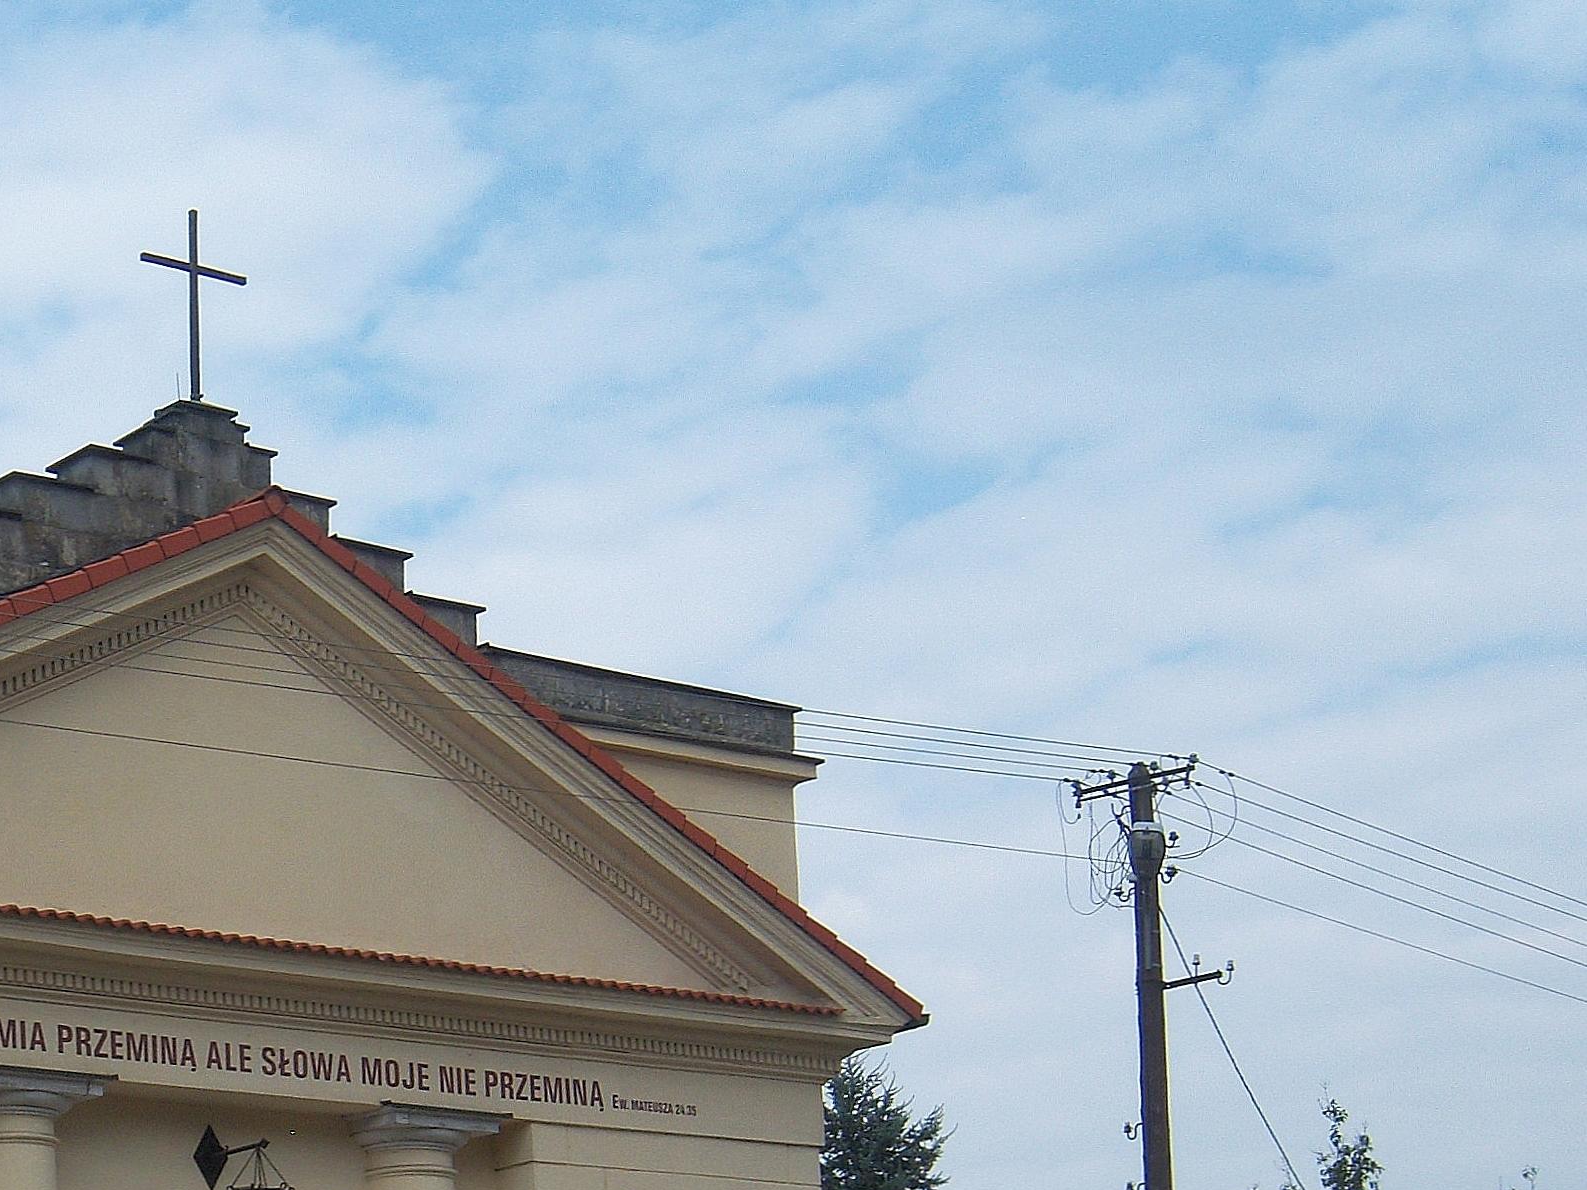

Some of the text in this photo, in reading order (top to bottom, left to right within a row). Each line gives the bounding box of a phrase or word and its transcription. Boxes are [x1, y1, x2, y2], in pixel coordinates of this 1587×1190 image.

[57, 1024, 197, 1072] PRZEMINĄ
[206, 1041, 253, 1073] ALE
[261, 1047, 351, 1083] SŁOWA
[361, 1056, 430, 1091] MOJE
[439, 1065, 476, 1096] NIE
[484, 1070, 605, 1112] PRZEMINĄ
